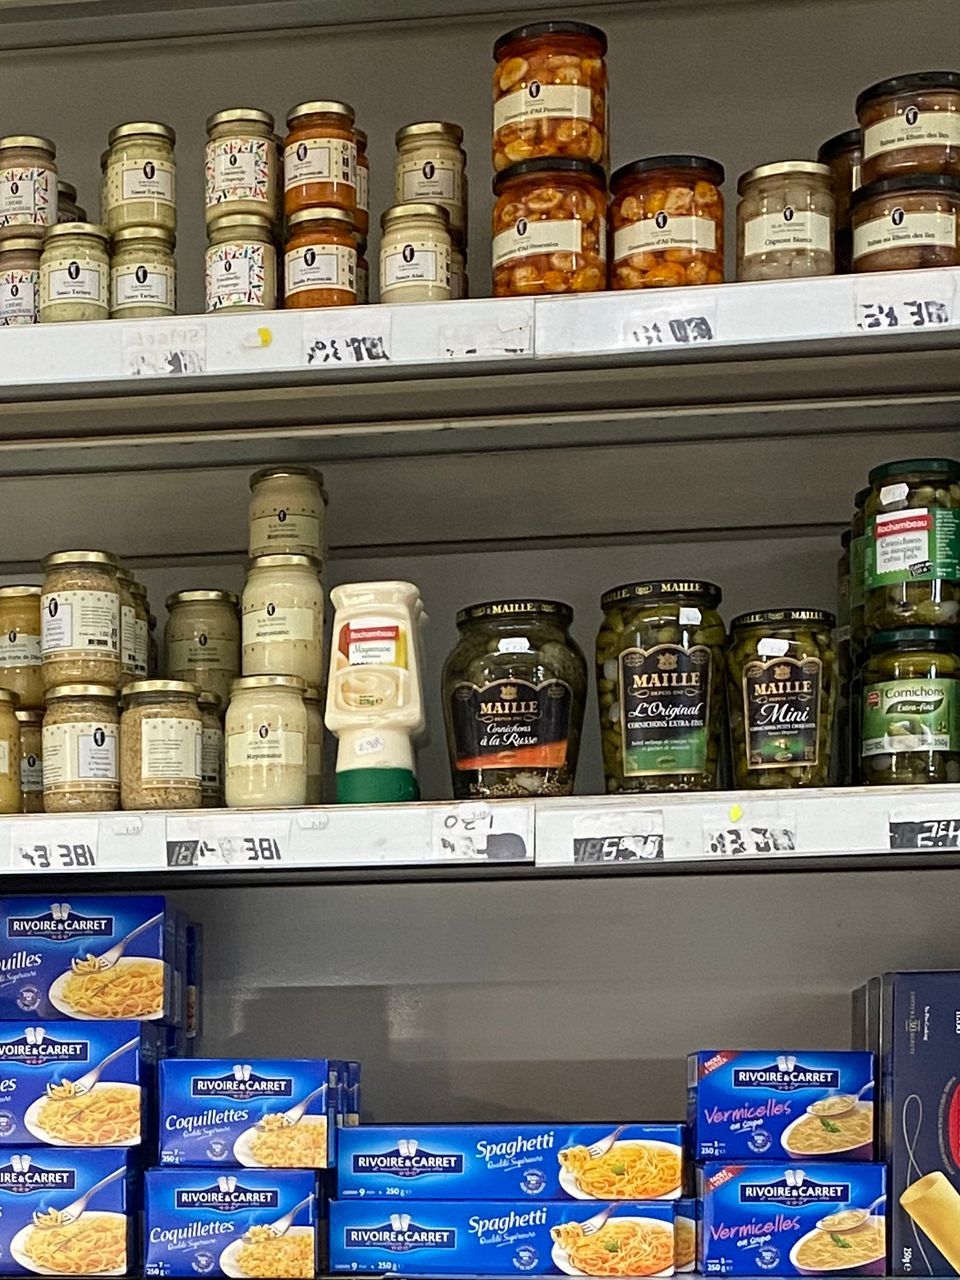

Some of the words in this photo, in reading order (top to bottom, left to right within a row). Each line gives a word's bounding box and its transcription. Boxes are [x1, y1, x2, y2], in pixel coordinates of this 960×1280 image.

[877, 517, 931, 534] Rochambeau
[632, 672, 701, 687] MAILLE
[754, 681, 812, 694] MAILLE
[885, 686, 944, 699] Cornichons
[480, 701, 538, 714] MAILLE
[759, 704, 809, 724] Mini
[166, 1109, 249, 1131] Coquillettes
[705, 1102, 792, 1124] Vermicelles
[476, 1132, 554, 1158] Spaghetti
[468, 1207, 546, 1234] Spaghetti
[710, 1216, 800, 1240] Vermicelles
[150, 1221, 234, 1244] Coquillettes
